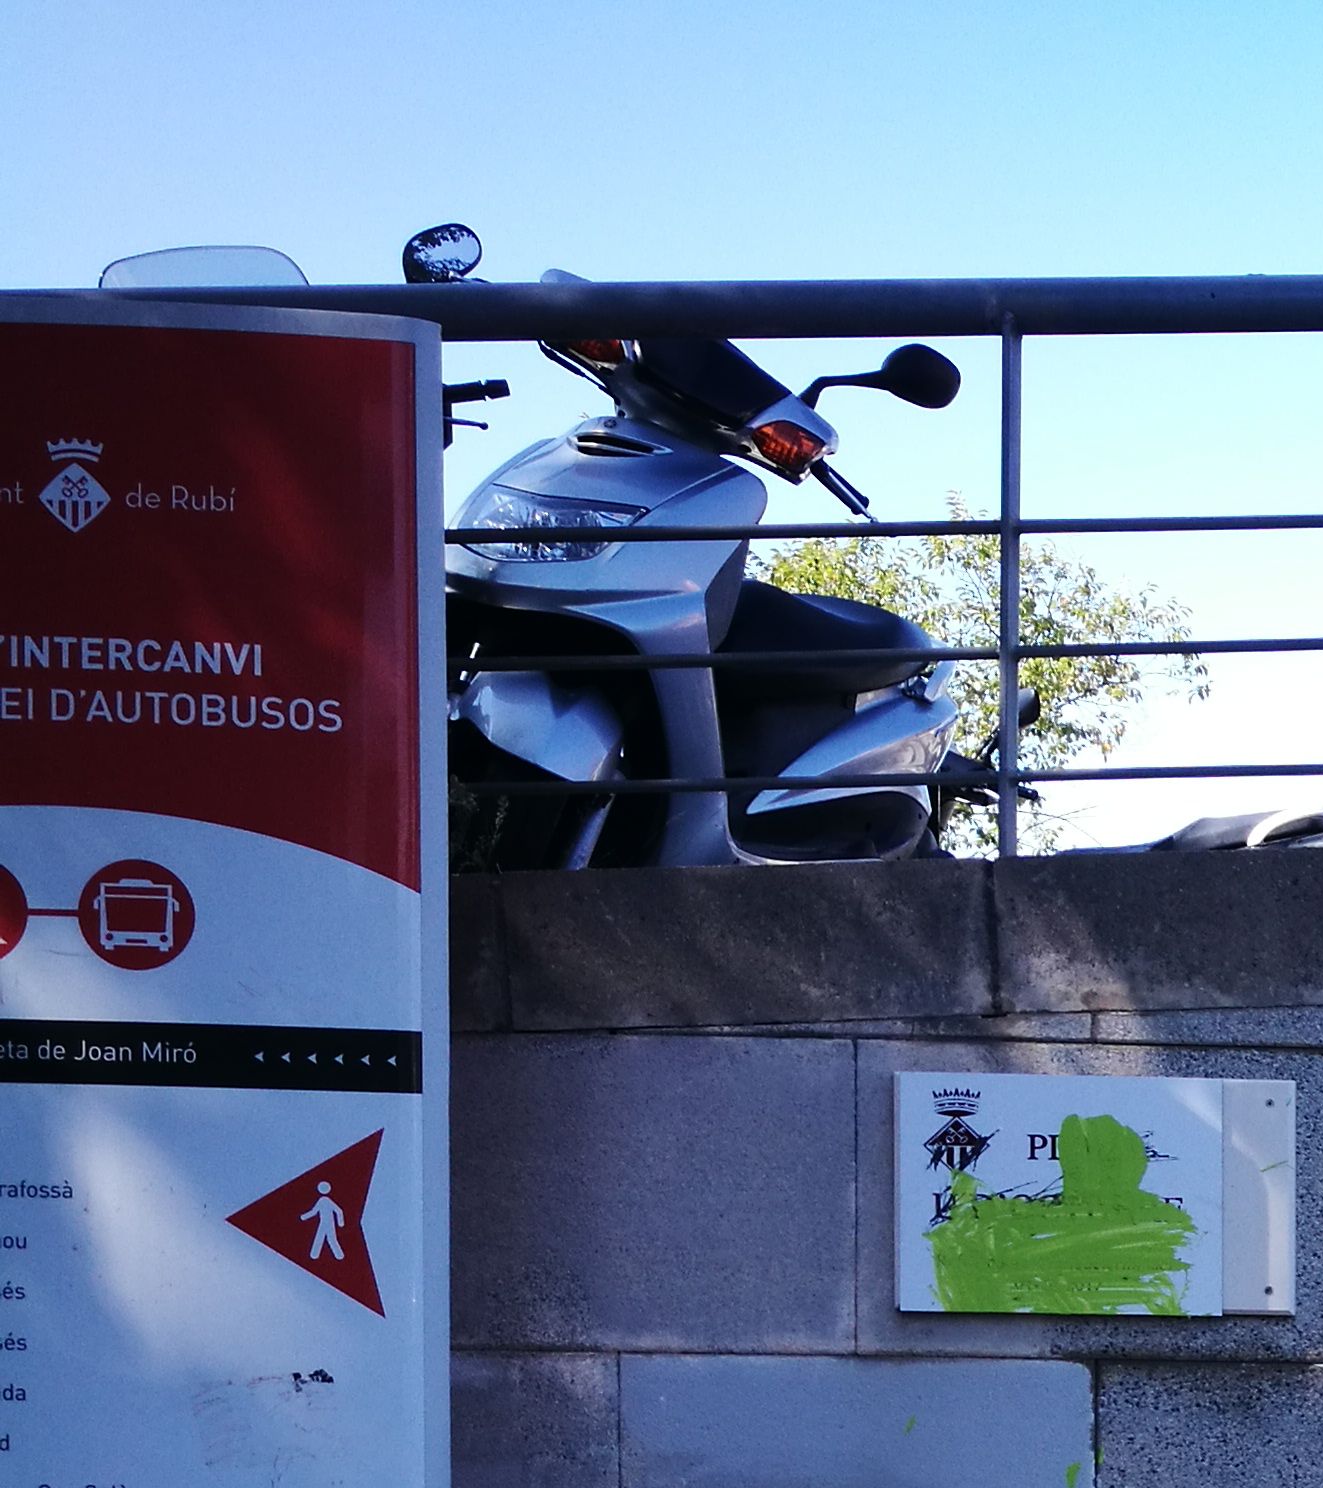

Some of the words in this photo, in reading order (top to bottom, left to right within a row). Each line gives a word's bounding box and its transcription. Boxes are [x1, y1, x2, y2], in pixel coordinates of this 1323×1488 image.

[126, 482, 161, 508] de
[172, 485, 236, 512] Rubí
[51, 688, 343, 732] D'AUTOBUSOS
[38, 1039, 66, 1061] de
[74, 1039, 133, 1062] Joan
[142, 1040, 197, 1064] Miró
